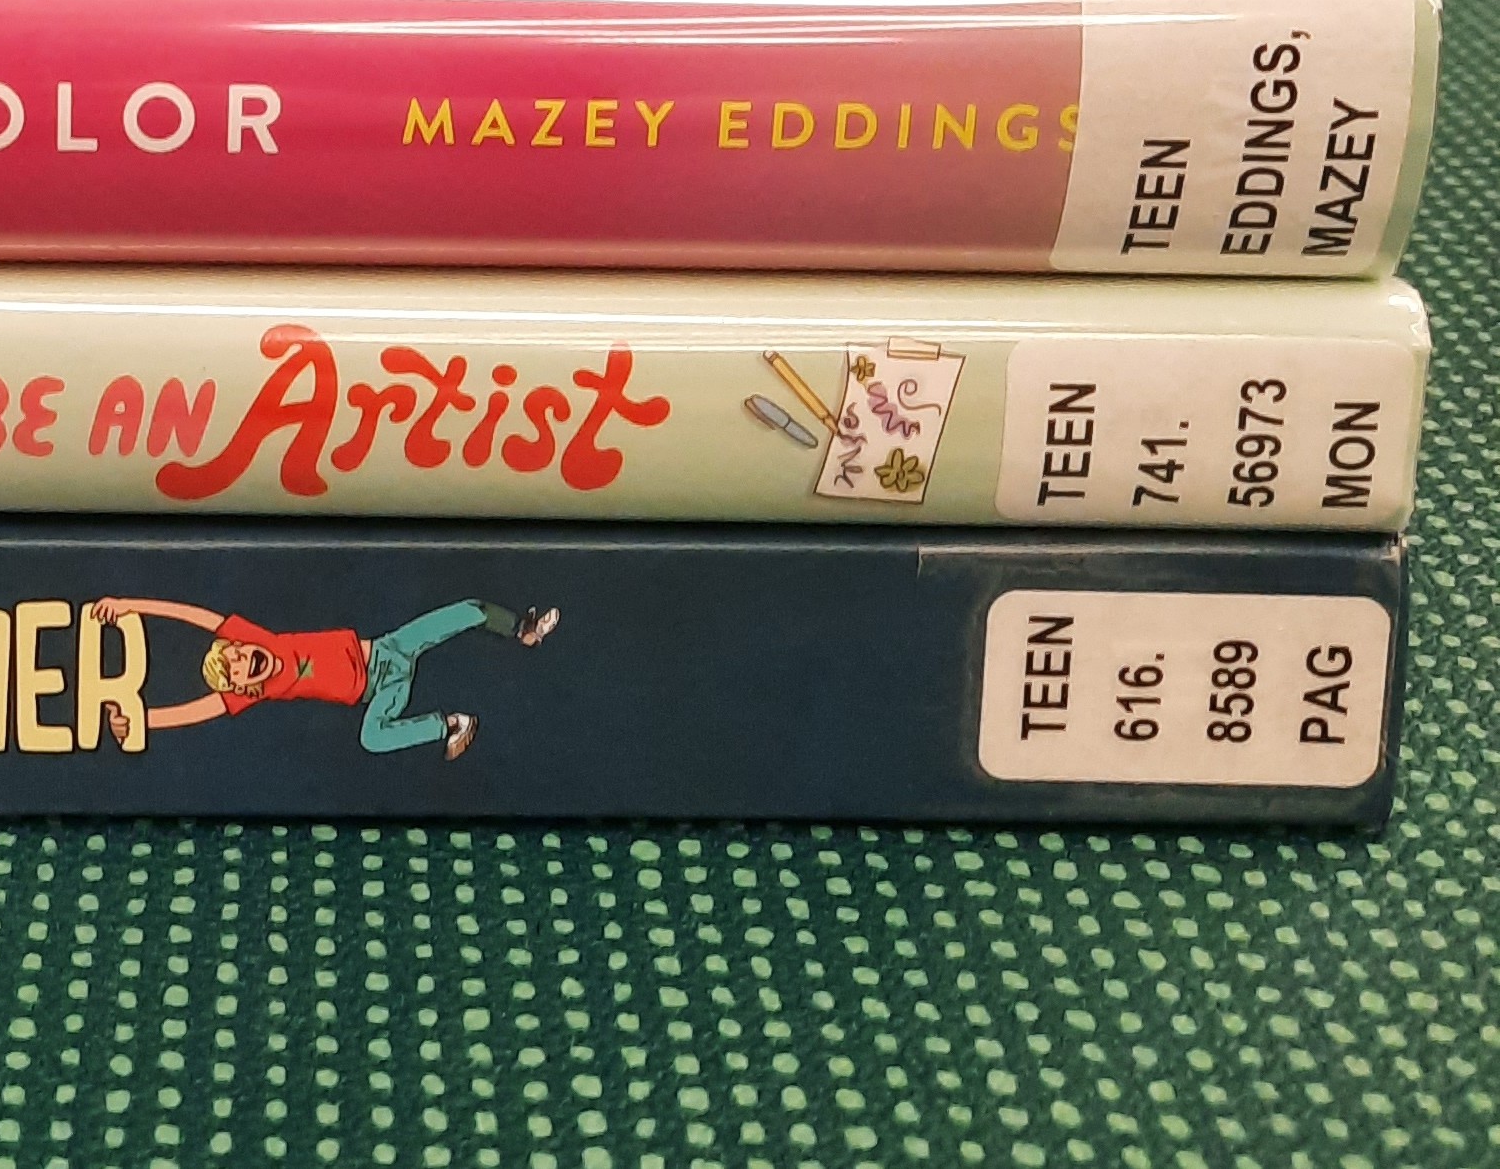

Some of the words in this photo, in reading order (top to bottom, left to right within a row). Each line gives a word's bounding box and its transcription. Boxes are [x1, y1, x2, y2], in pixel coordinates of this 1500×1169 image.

[401, 97, 675, 150] MAZEY
[1219, 29, 1313, 256] EDDINGS,
[1300, 95, 1380, 257] MAZEY
[1120, 137, 1192, 256] TEEN
[88, 374, 216, 459] AN
[155, 322, 672, 501] Artist
[1037, 380, 1098, 508] TEEN
[1133, 418, 1190, 509] 741.
[1227, 378, 1288, 509] 56973
[1321, 400, 1381, 510] MON
[1020, 614, 1076, 742] TEEN
[1113, 651, 1166, 743] 616.
[1206, 638, 1260, 744] 8589
[1298, 643, 1355, 745] PAG
